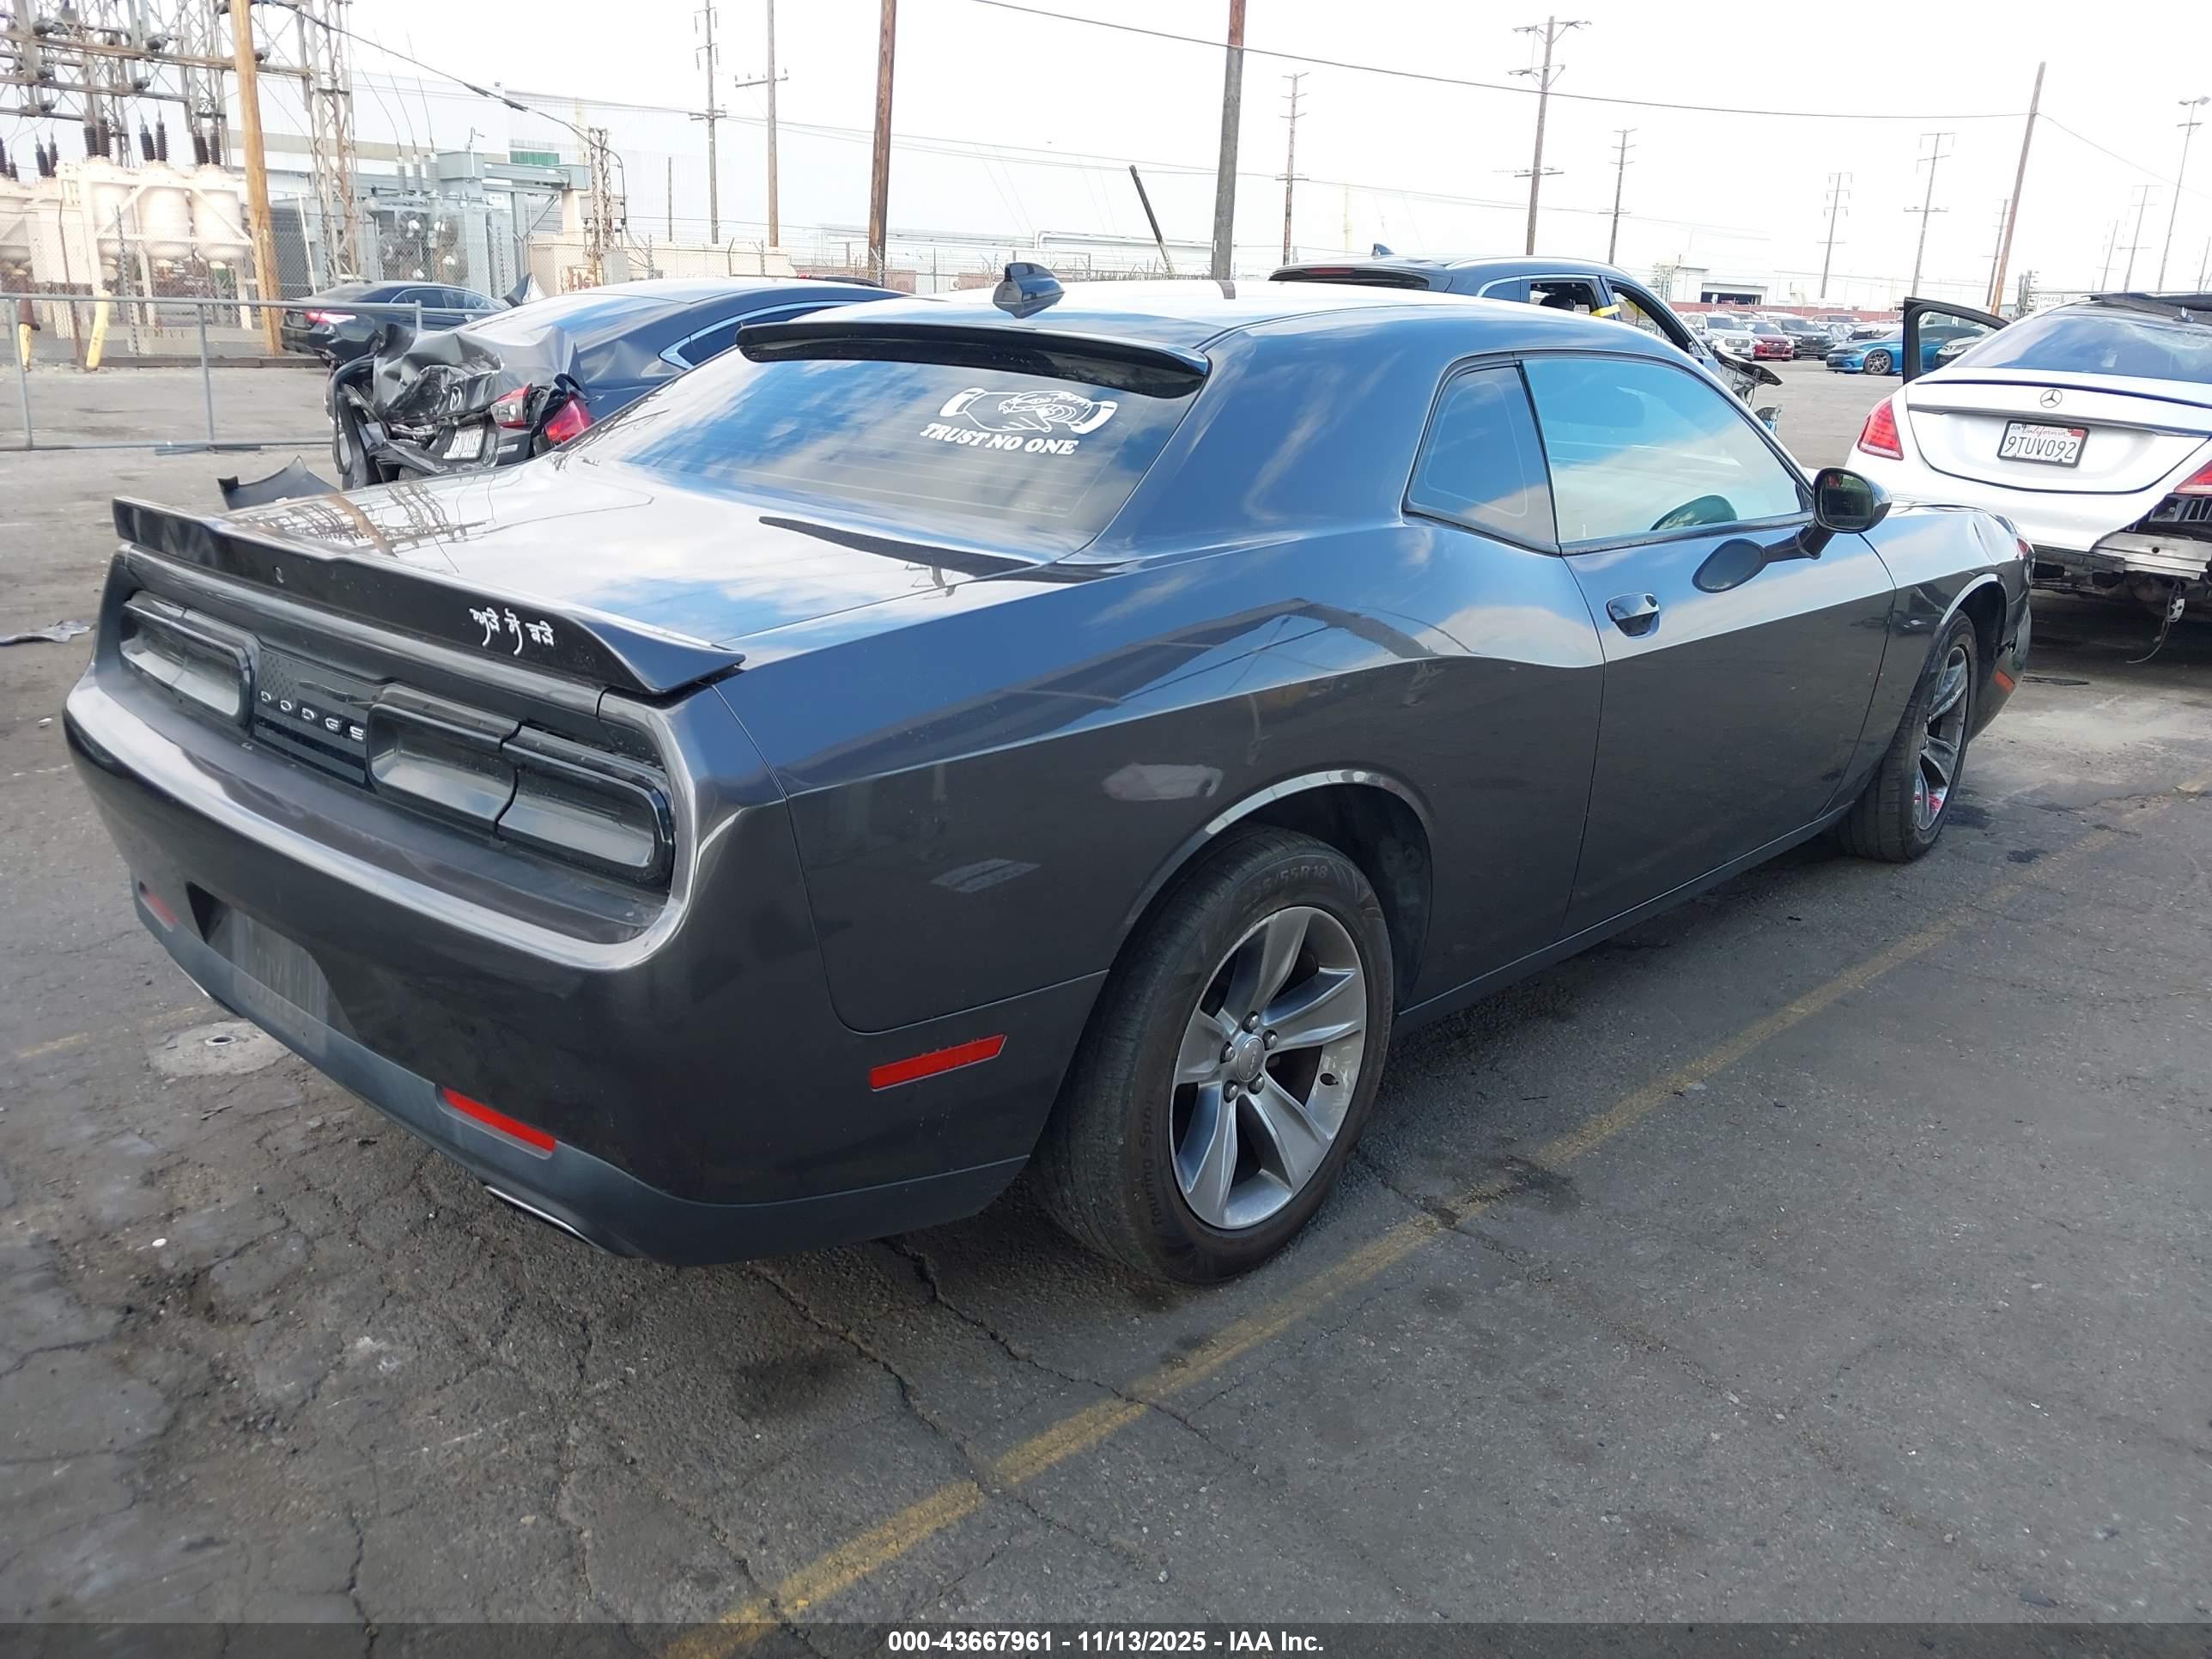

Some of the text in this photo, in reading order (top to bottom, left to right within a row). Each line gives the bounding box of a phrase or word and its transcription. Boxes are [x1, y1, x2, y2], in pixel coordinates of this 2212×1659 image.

[920, 422, 1079, 456] TRUST NO ONE
[2004, 435, 2077, 459] 9TUV092
[260, 690, 365, 741] DODGE
